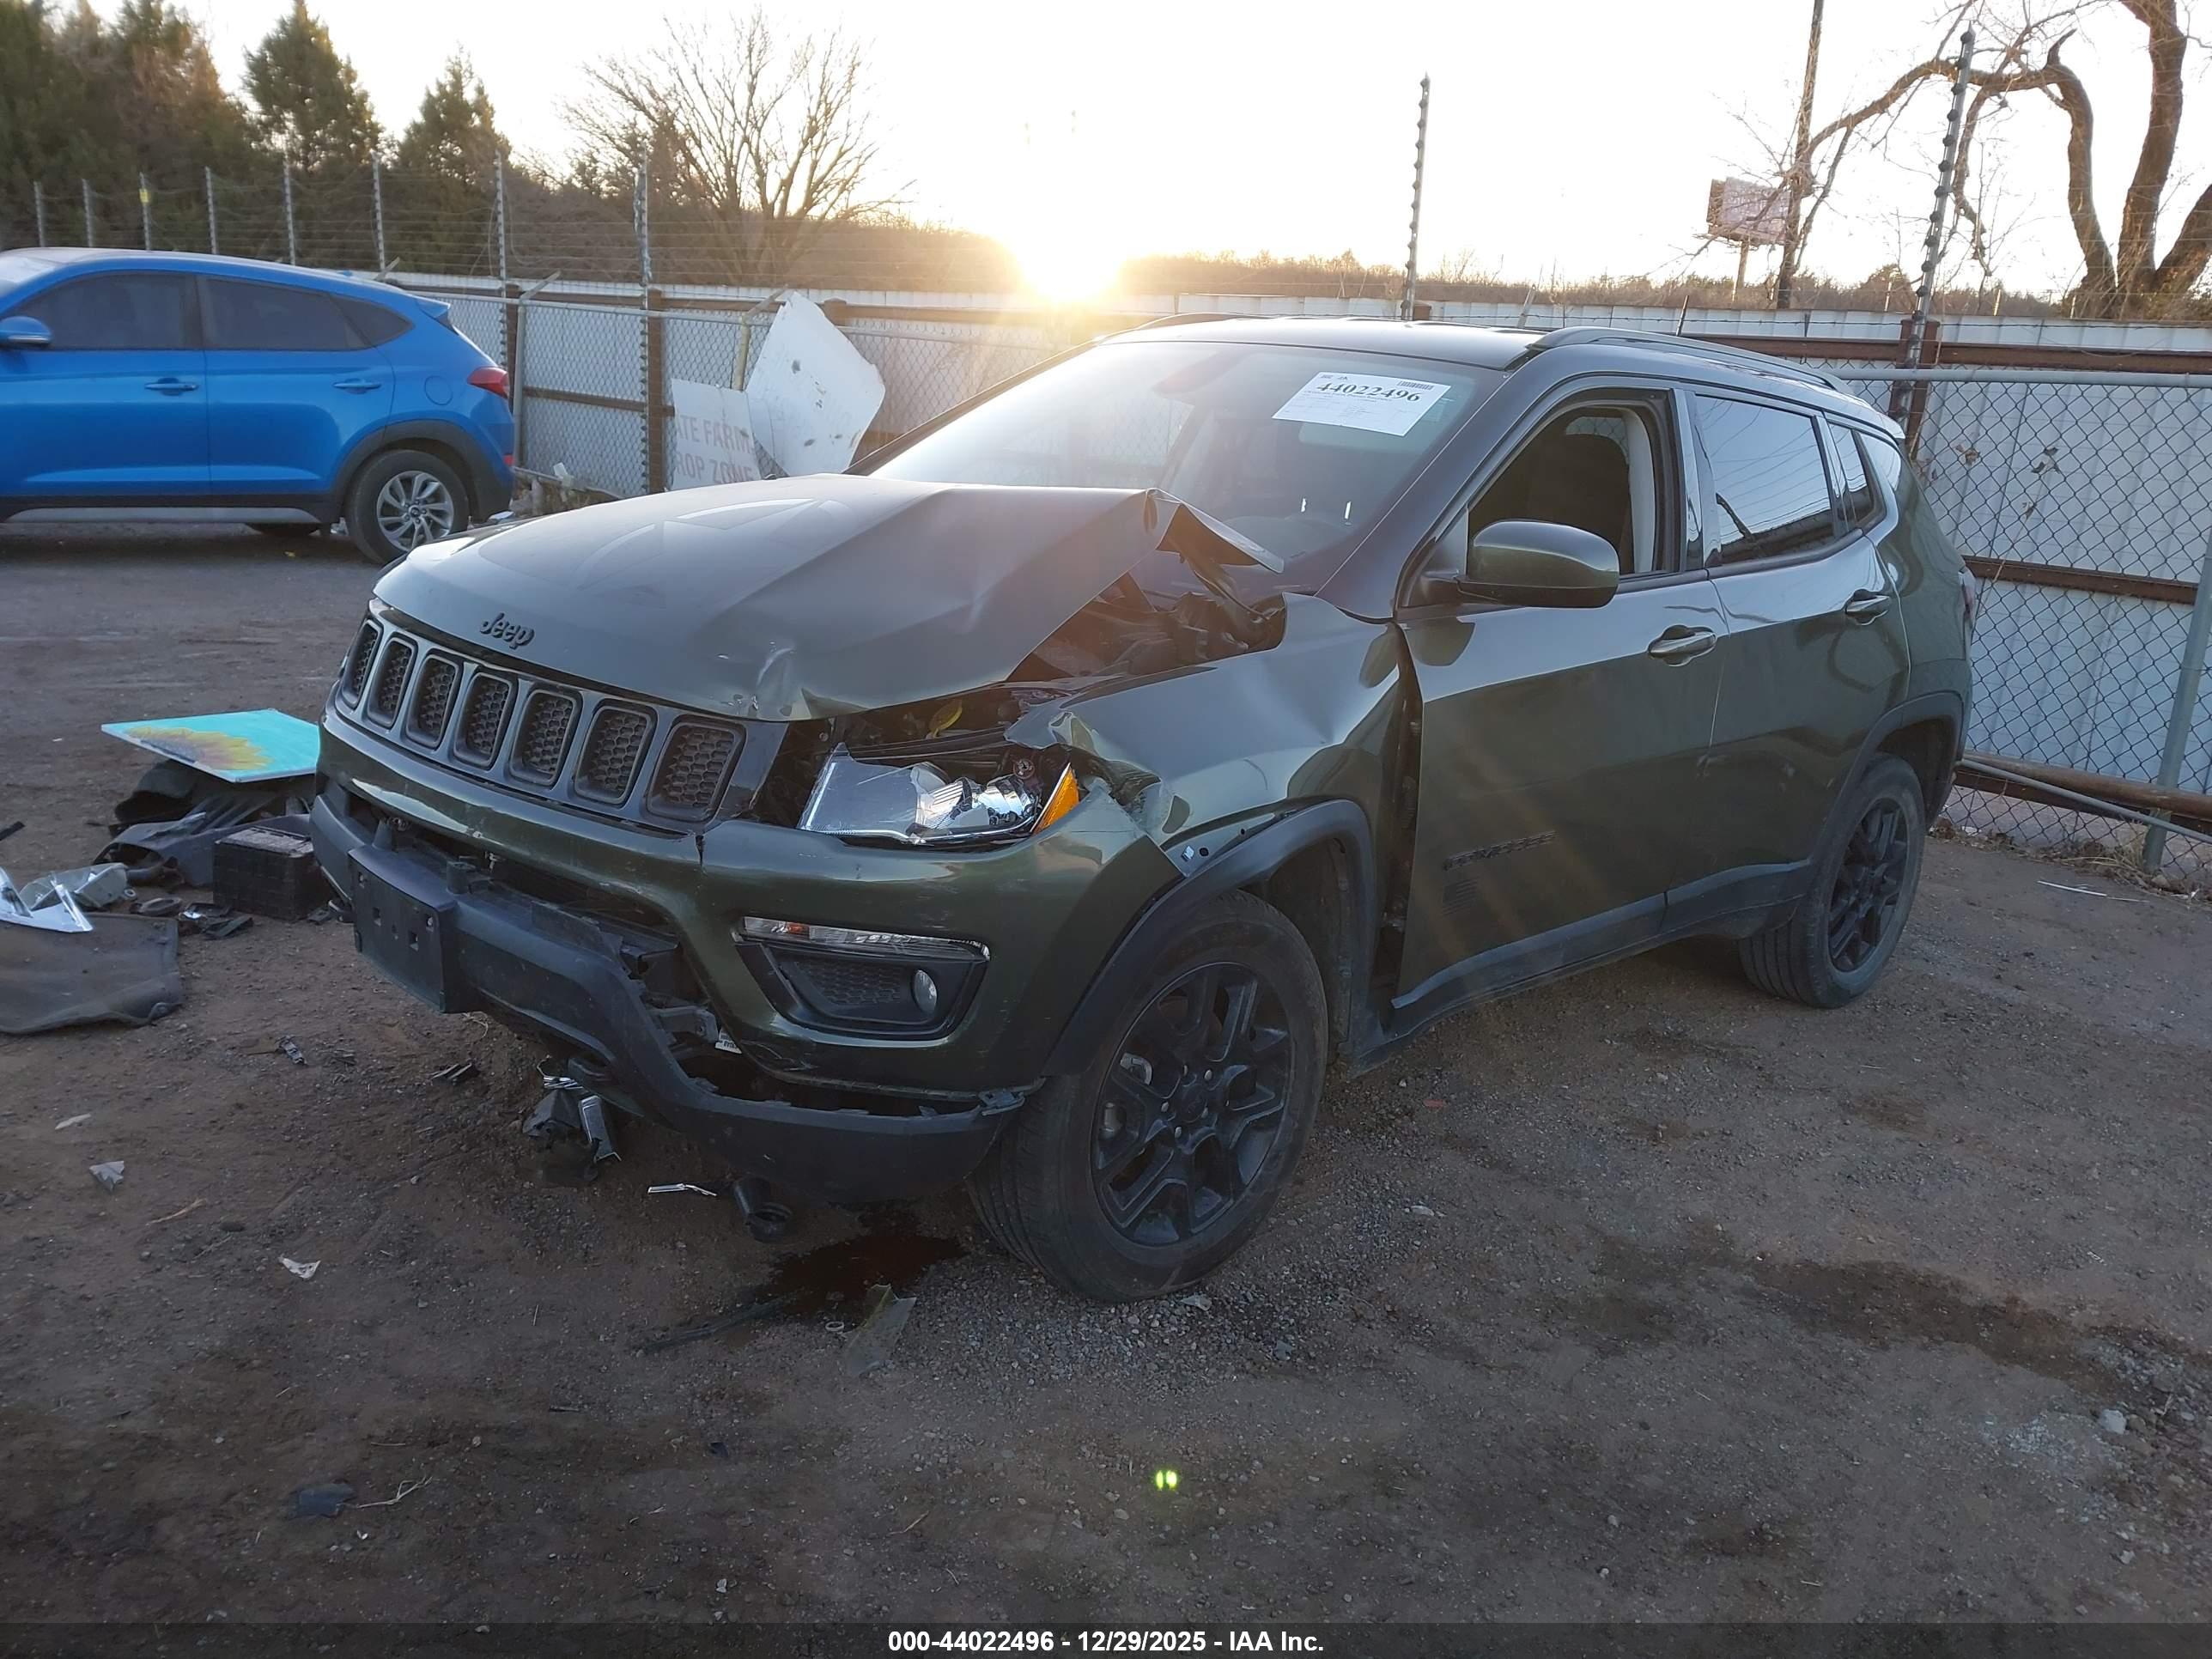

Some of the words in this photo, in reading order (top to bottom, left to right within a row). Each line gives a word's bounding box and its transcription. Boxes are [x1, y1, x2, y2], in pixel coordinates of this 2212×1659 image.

[1317, 382, 1422, 402] 44022496
[703, 418, 751, 454] FARM
[709, 459, 755, 484] ZONE
[479, 612, 536, 650] Jeep
